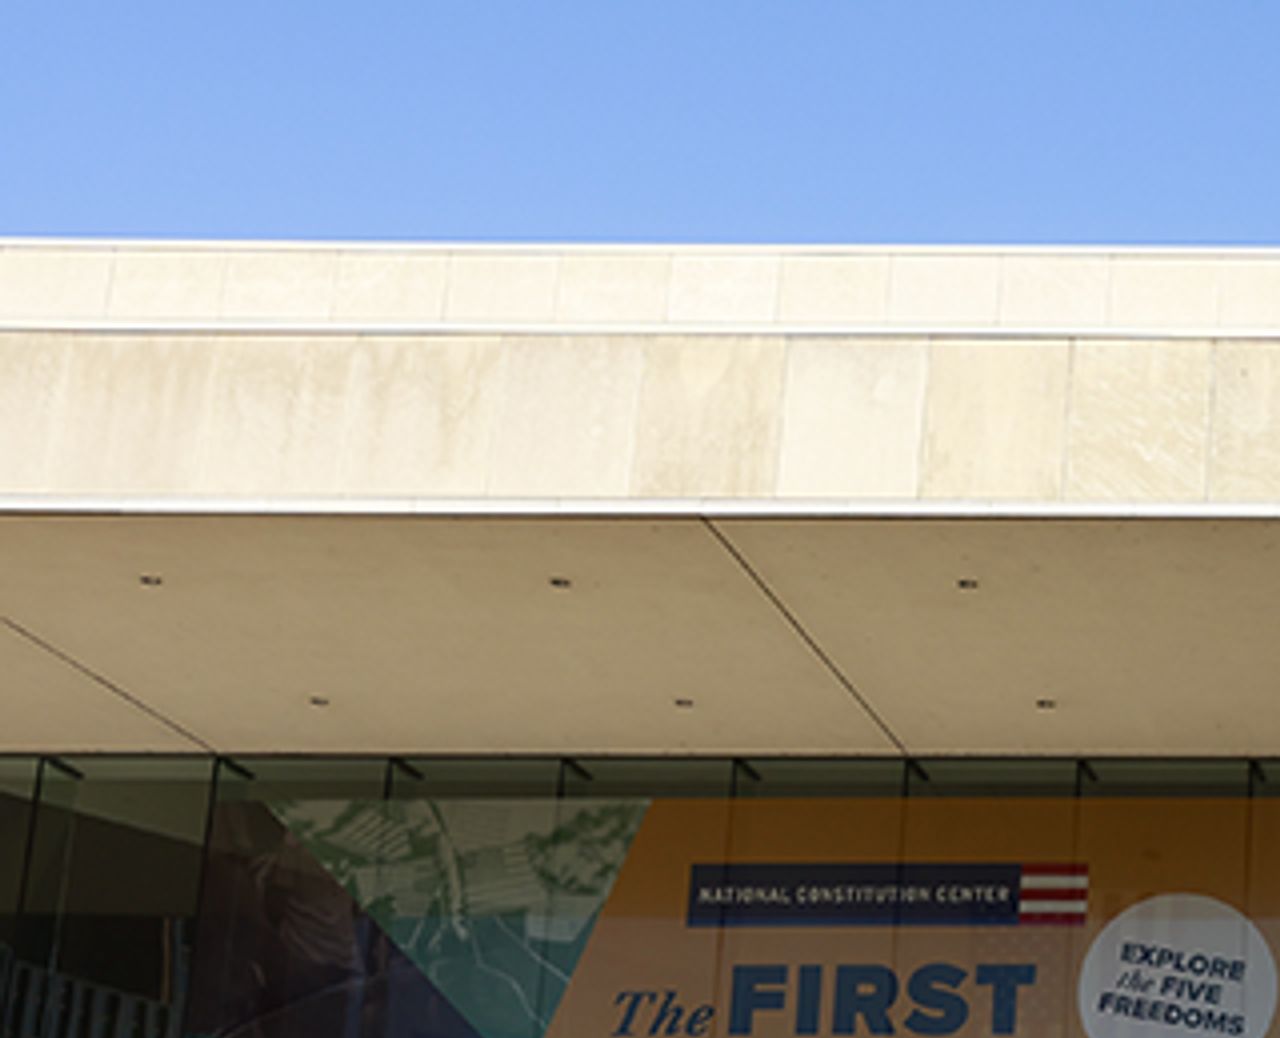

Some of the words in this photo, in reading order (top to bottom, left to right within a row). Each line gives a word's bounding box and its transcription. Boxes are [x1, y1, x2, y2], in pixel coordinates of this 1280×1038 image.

[698, 886, 792, 905] NATIONAL
[795, 885, 931, 905] CONSTITUTION
[935, 885, 1011, 904] CENTER
[1120, 942, 1246, 981] EXPLORE
[609, 990, 716, 1038] The
[727, 963, 1037, 1037] FIRST
[1116, 968, 1155, 992] the
[1160, 975, 1224, 1005] FIVE
[1097, 991, 1246, 1037] FREEDOMS
